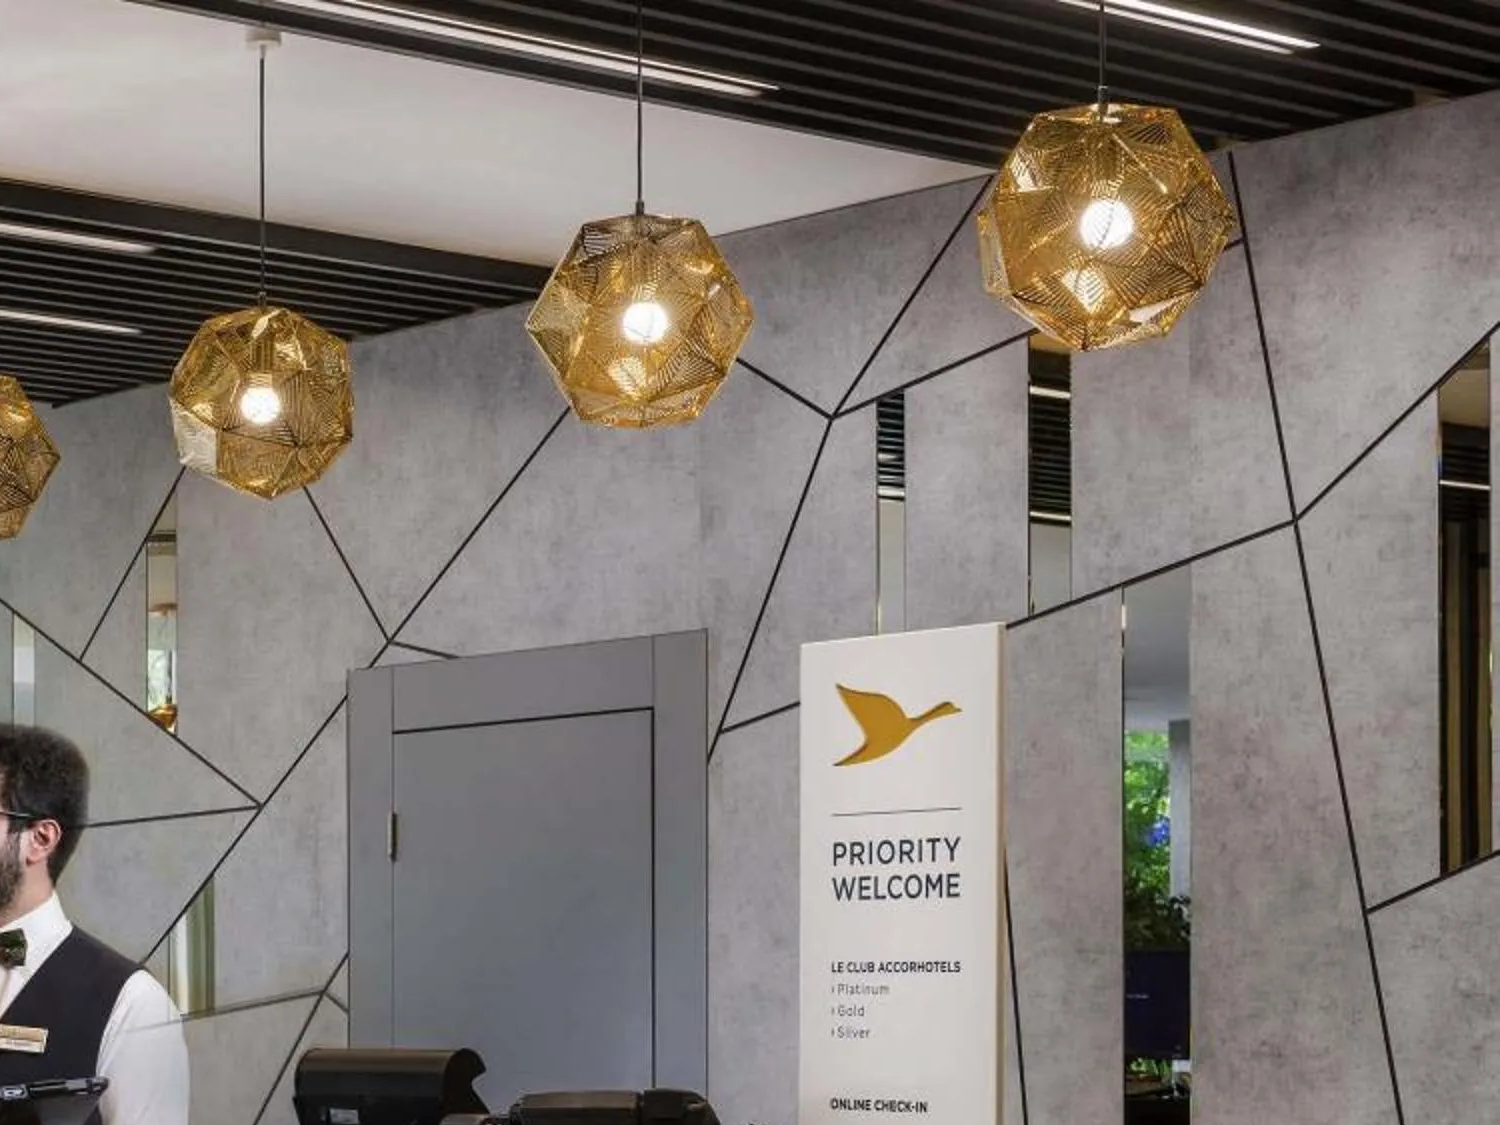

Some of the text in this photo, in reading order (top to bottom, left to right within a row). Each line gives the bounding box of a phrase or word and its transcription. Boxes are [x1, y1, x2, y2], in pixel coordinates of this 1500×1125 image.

[832, 836, 961, 866] PRIORITY
[831, 873, 961, 901] WELCOME
[831, 961, 961, 973] LE CLUB ACCORHOTELS
[837, 983, 890, 996] Platinum
[837, 1004, 865, 1017] Gold
[837, 1026, 871, 1039] Silver
[830, 1098, 928, 1113] ONLINE CHECK-IN
